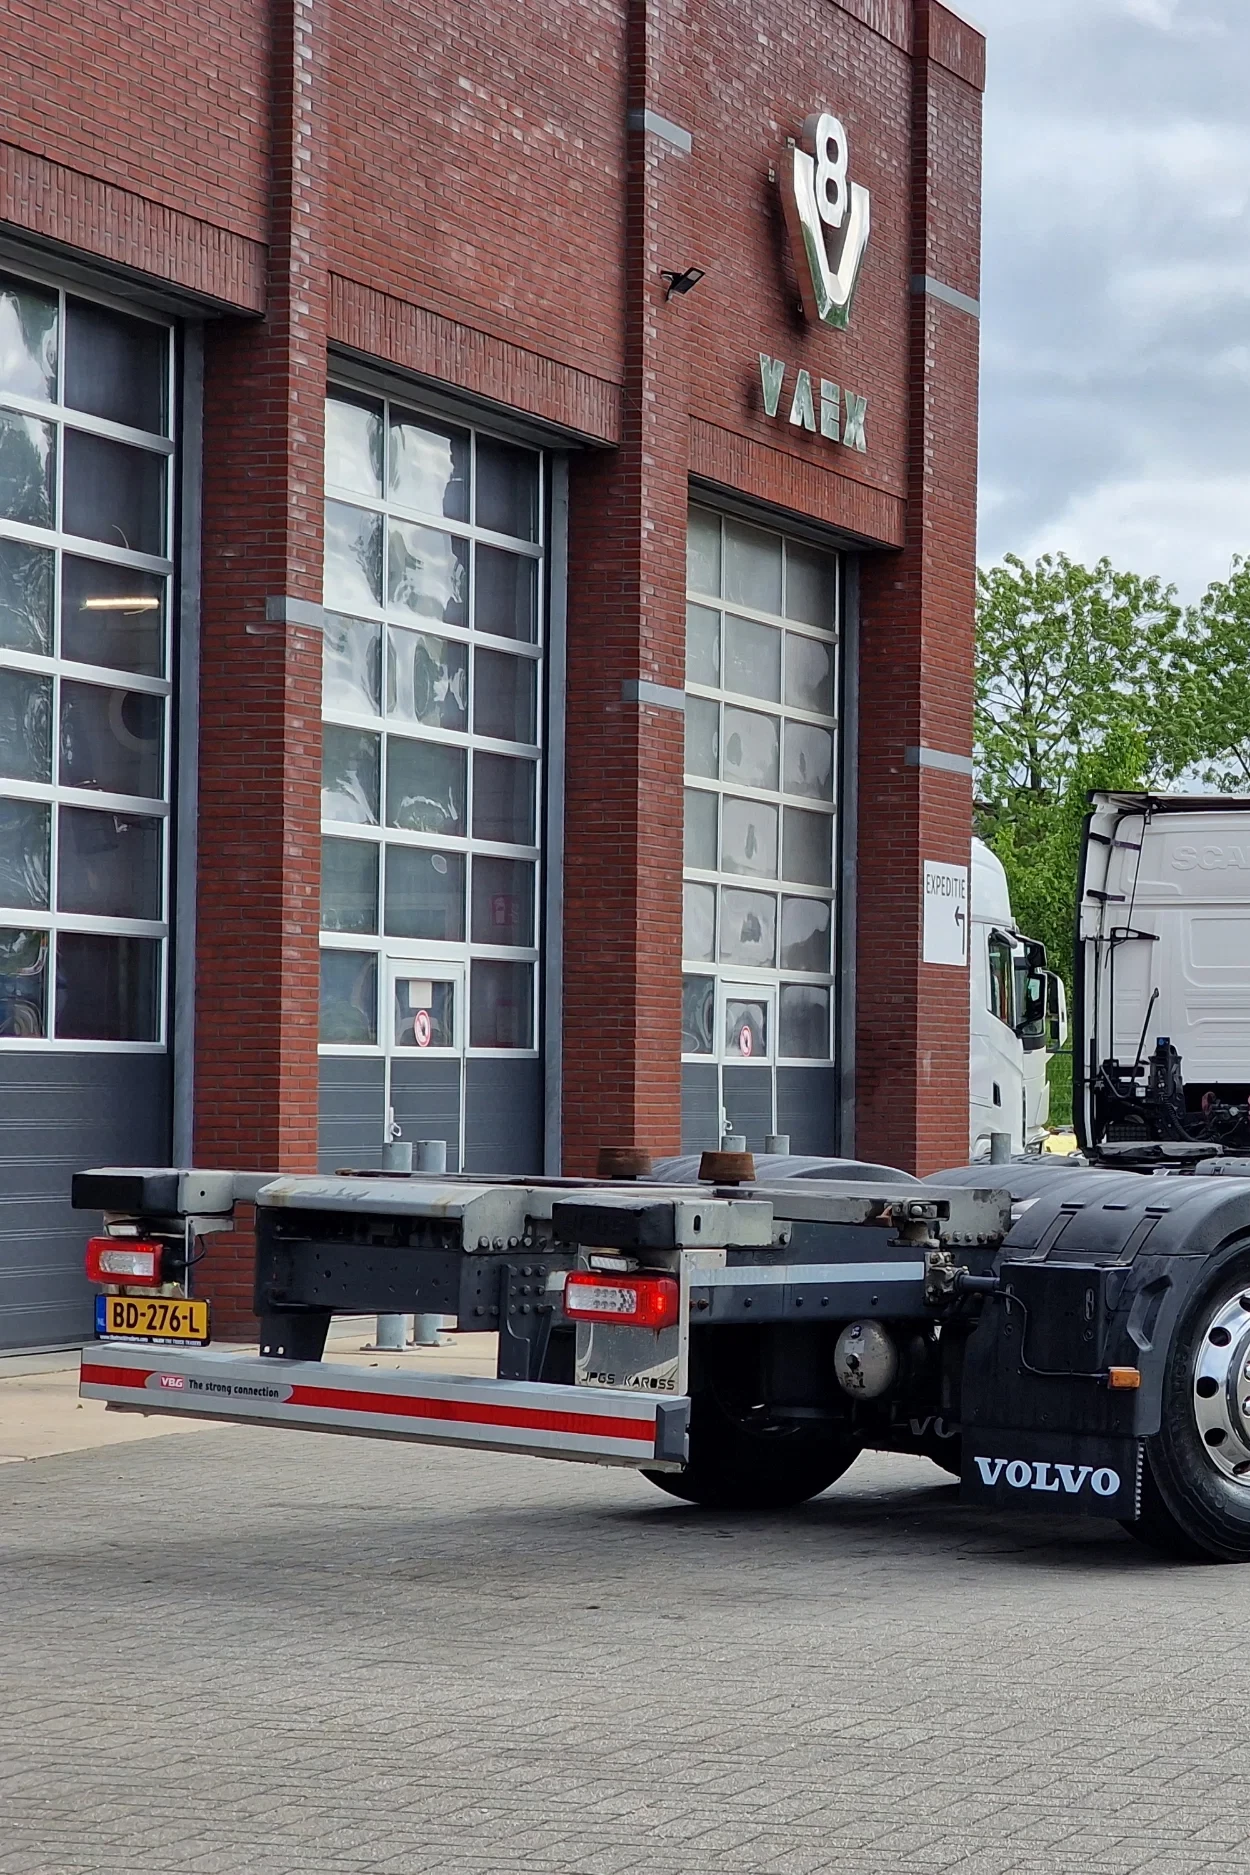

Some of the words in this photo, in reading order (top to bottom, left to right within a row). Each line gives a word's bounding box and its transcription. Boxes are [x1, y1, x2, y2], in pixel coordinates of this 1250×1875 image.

[759, 352, 868, 454] VAEX
[926, 873, 966, 899] EXPEDITIE
[113, 1302, 201, 1334] BD-276-L
[161, 1376, 183, 1388] VBG
[188, 1379, 203, 1391] The
[205, 1382, 231, 1396] strong
[233, 1385, 279, 1398] connection
[623, 1374, 676, 1391] KAROSS
[974, 1455, 1121, 1497] VOLVO
